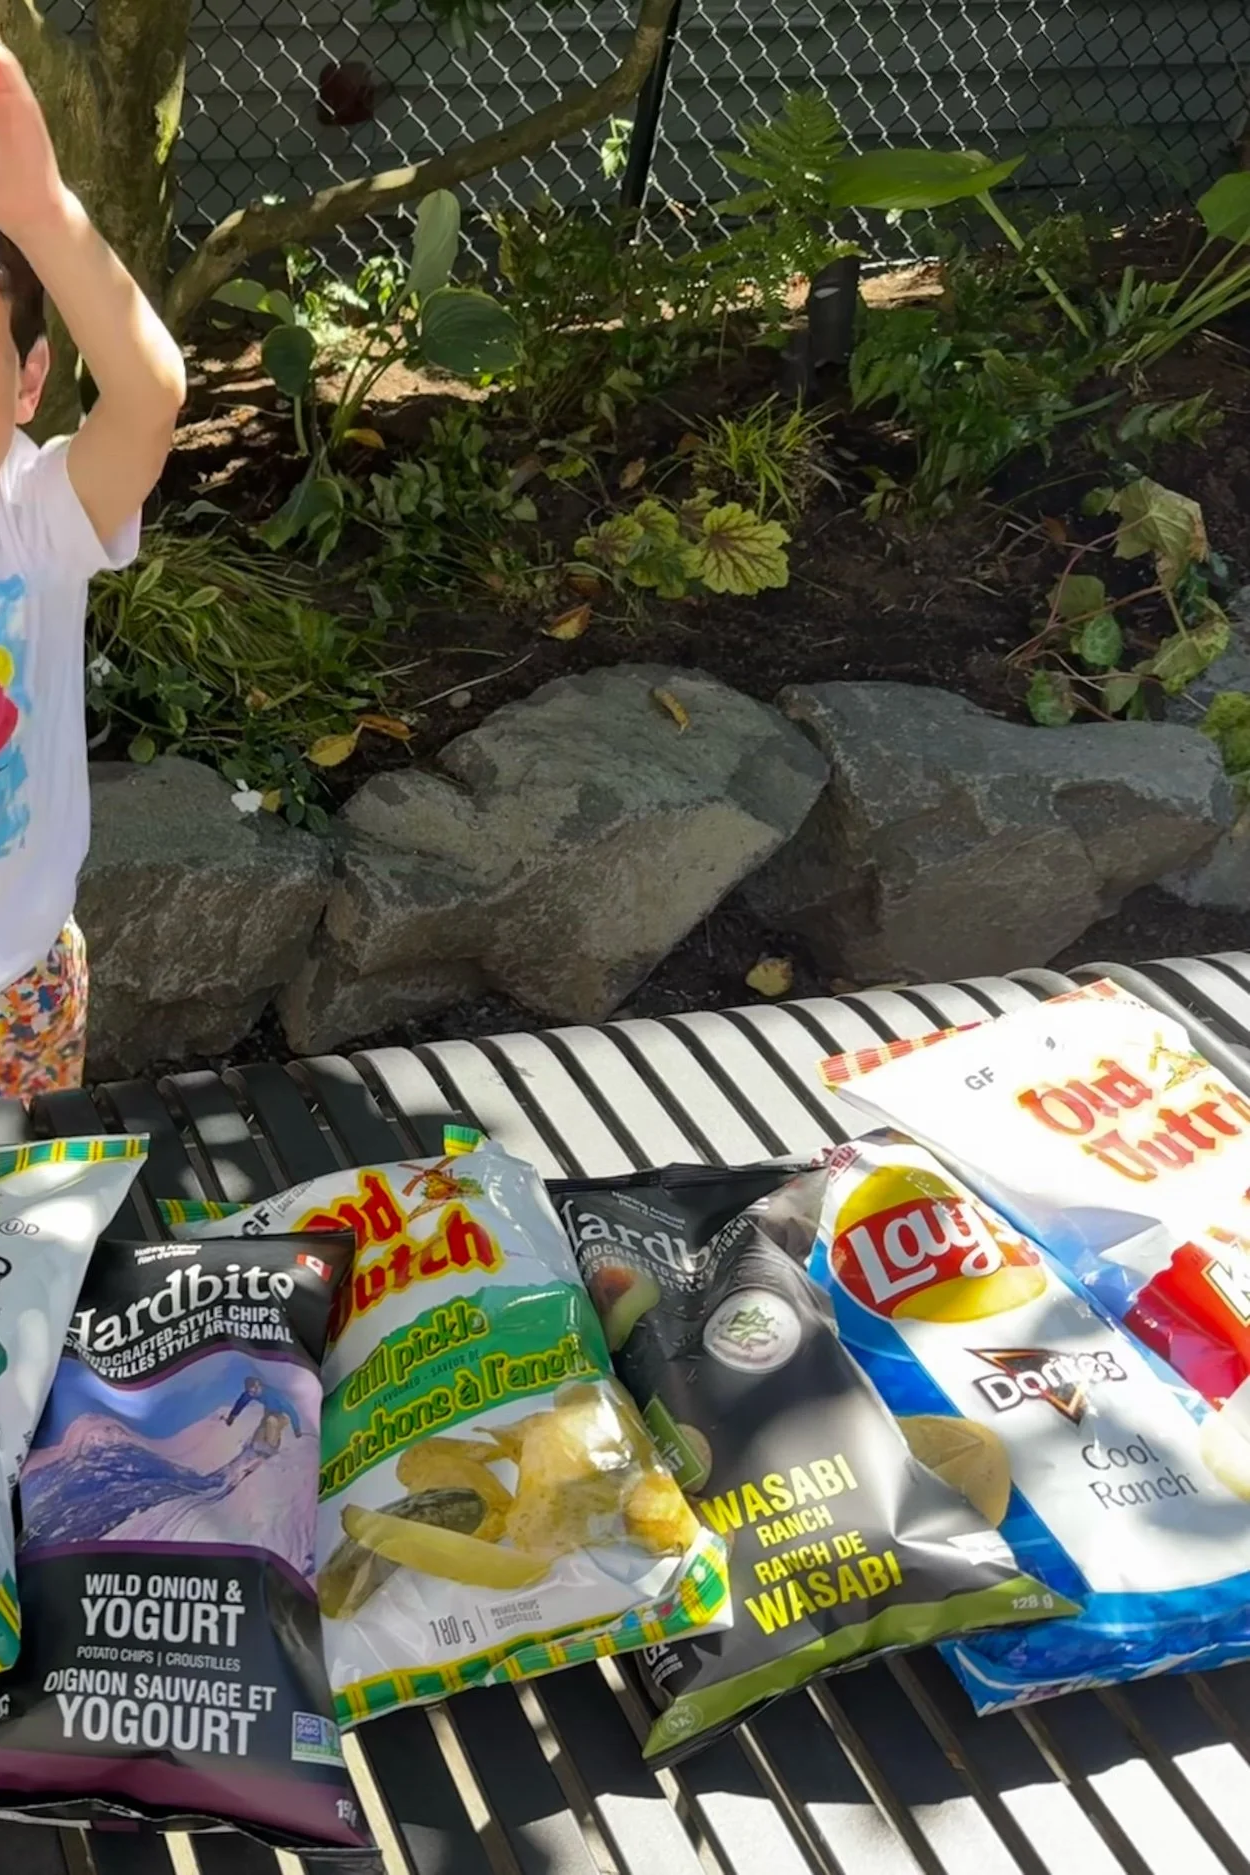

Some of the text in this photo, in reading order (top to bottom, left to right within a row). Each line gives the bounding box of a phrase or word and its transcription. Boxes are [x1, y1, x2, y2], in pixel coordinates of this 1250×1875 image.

[964, 1066, 995, 1091] GF
[1018, 1059, 1154, 1137] Old
[242, 1205, 270, 1236] GF
[340, 1211, 496, 1325] utch
[228, 1304, 281, 1324] CHIPS
[158, 1329, 201, 1361] STYLE
[204, 1320, 295, 1344] ARTISANAL
[344, 1301, 488, 1411] dill pickle
[455, 1370, 481, 1407] à
[973, 1350, 1128, 1413] Doritos
[1082, 1434, 1160, 1471] Cool
[700, 1453, 859, 1535] WASABI
[1089, 1467, 1199, 1510] Ranch
[756, 1504, 834, 1548] RANCH
[754, 1530, 868, 1586] RANCH DE
[85, 1574, 243, 1602] WILD ONION &
[744, 1550, 903, 1635] WASABI
[81, 1598, 245, 1647] YOGURT
[429, 1615, 477, 1647] 180 g
[76, 1646, 242, 1672] POTATO CHIPS CROUSTILLES
[134, 1672, 242, 1703] SAUVAGE
[248, 1686, 277, 1711] ET
[56, 1694, 257, 1756] YOGOURT
